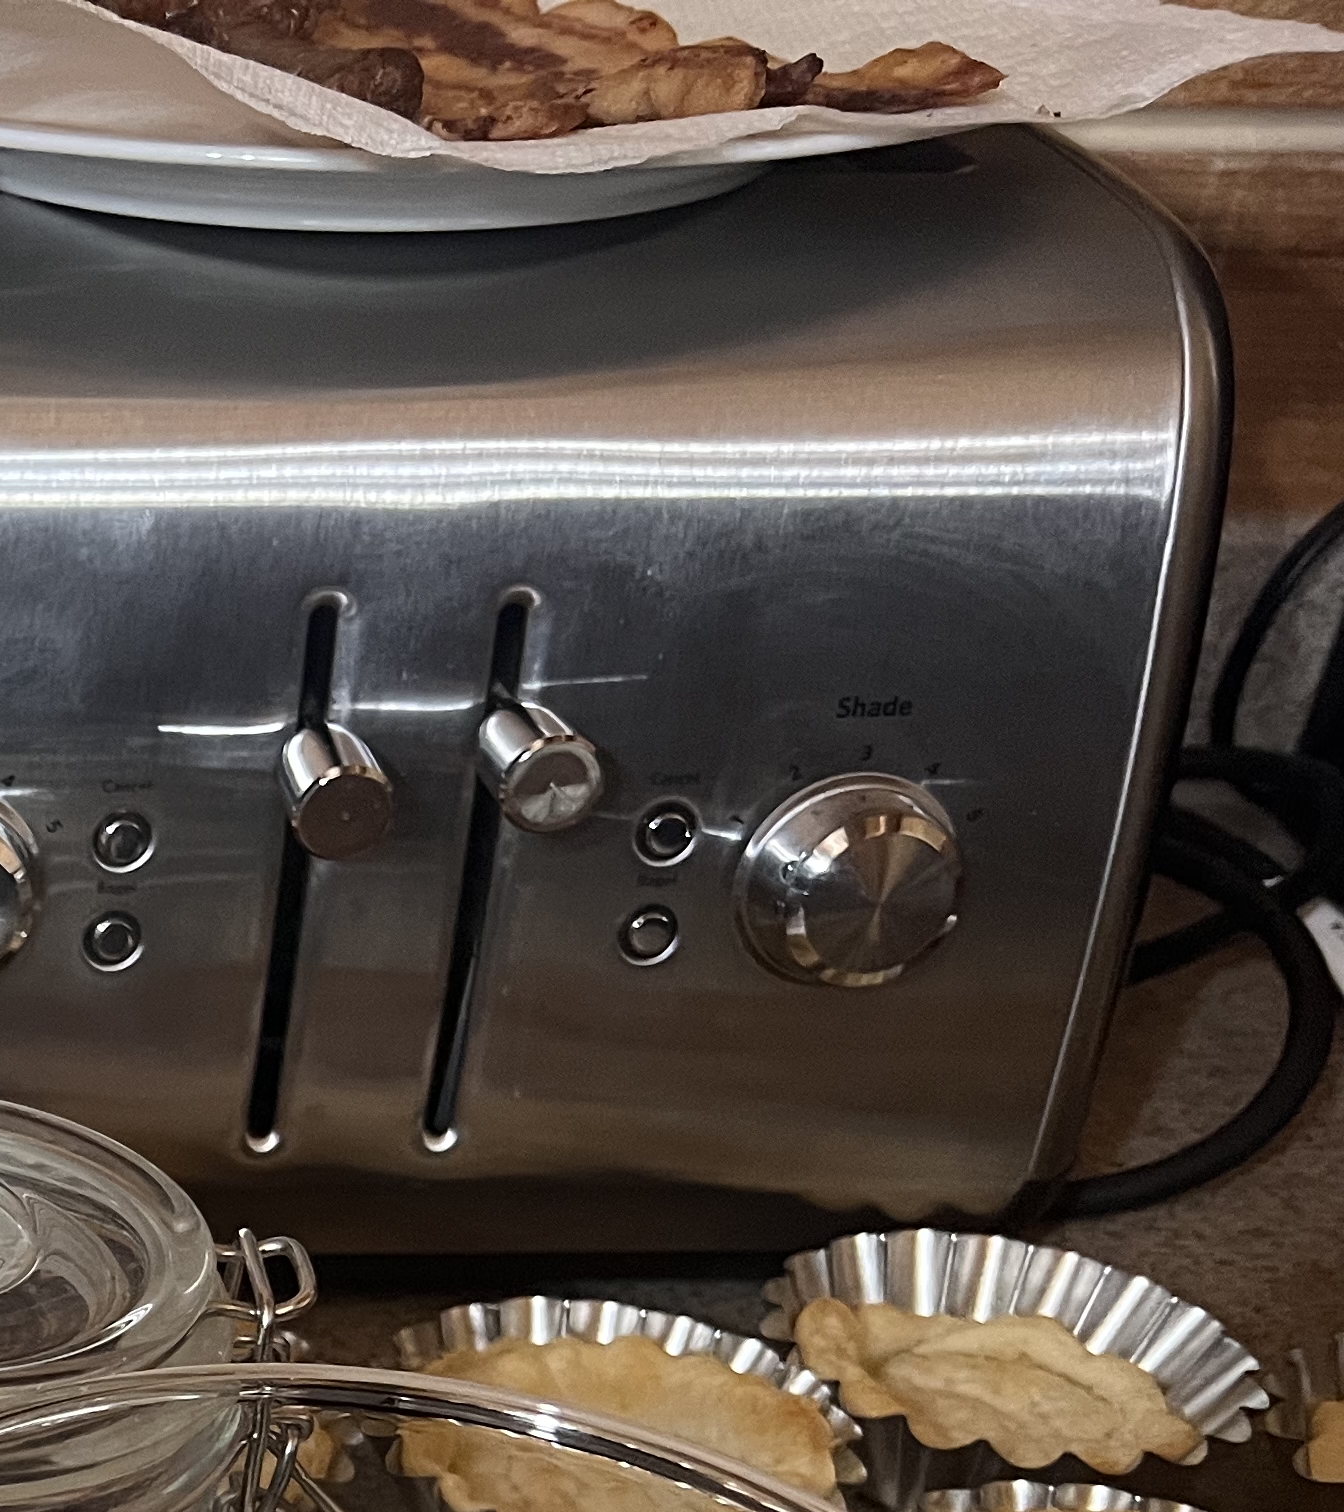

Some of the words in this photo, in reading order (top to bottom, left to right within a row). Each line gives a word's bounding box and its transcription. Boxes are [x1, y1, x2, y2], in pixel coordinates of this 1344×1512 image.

[834, 695, 913, 719] Shade
[861, 744, 874, 761] 3
[45, 818, 65, 834] 5
